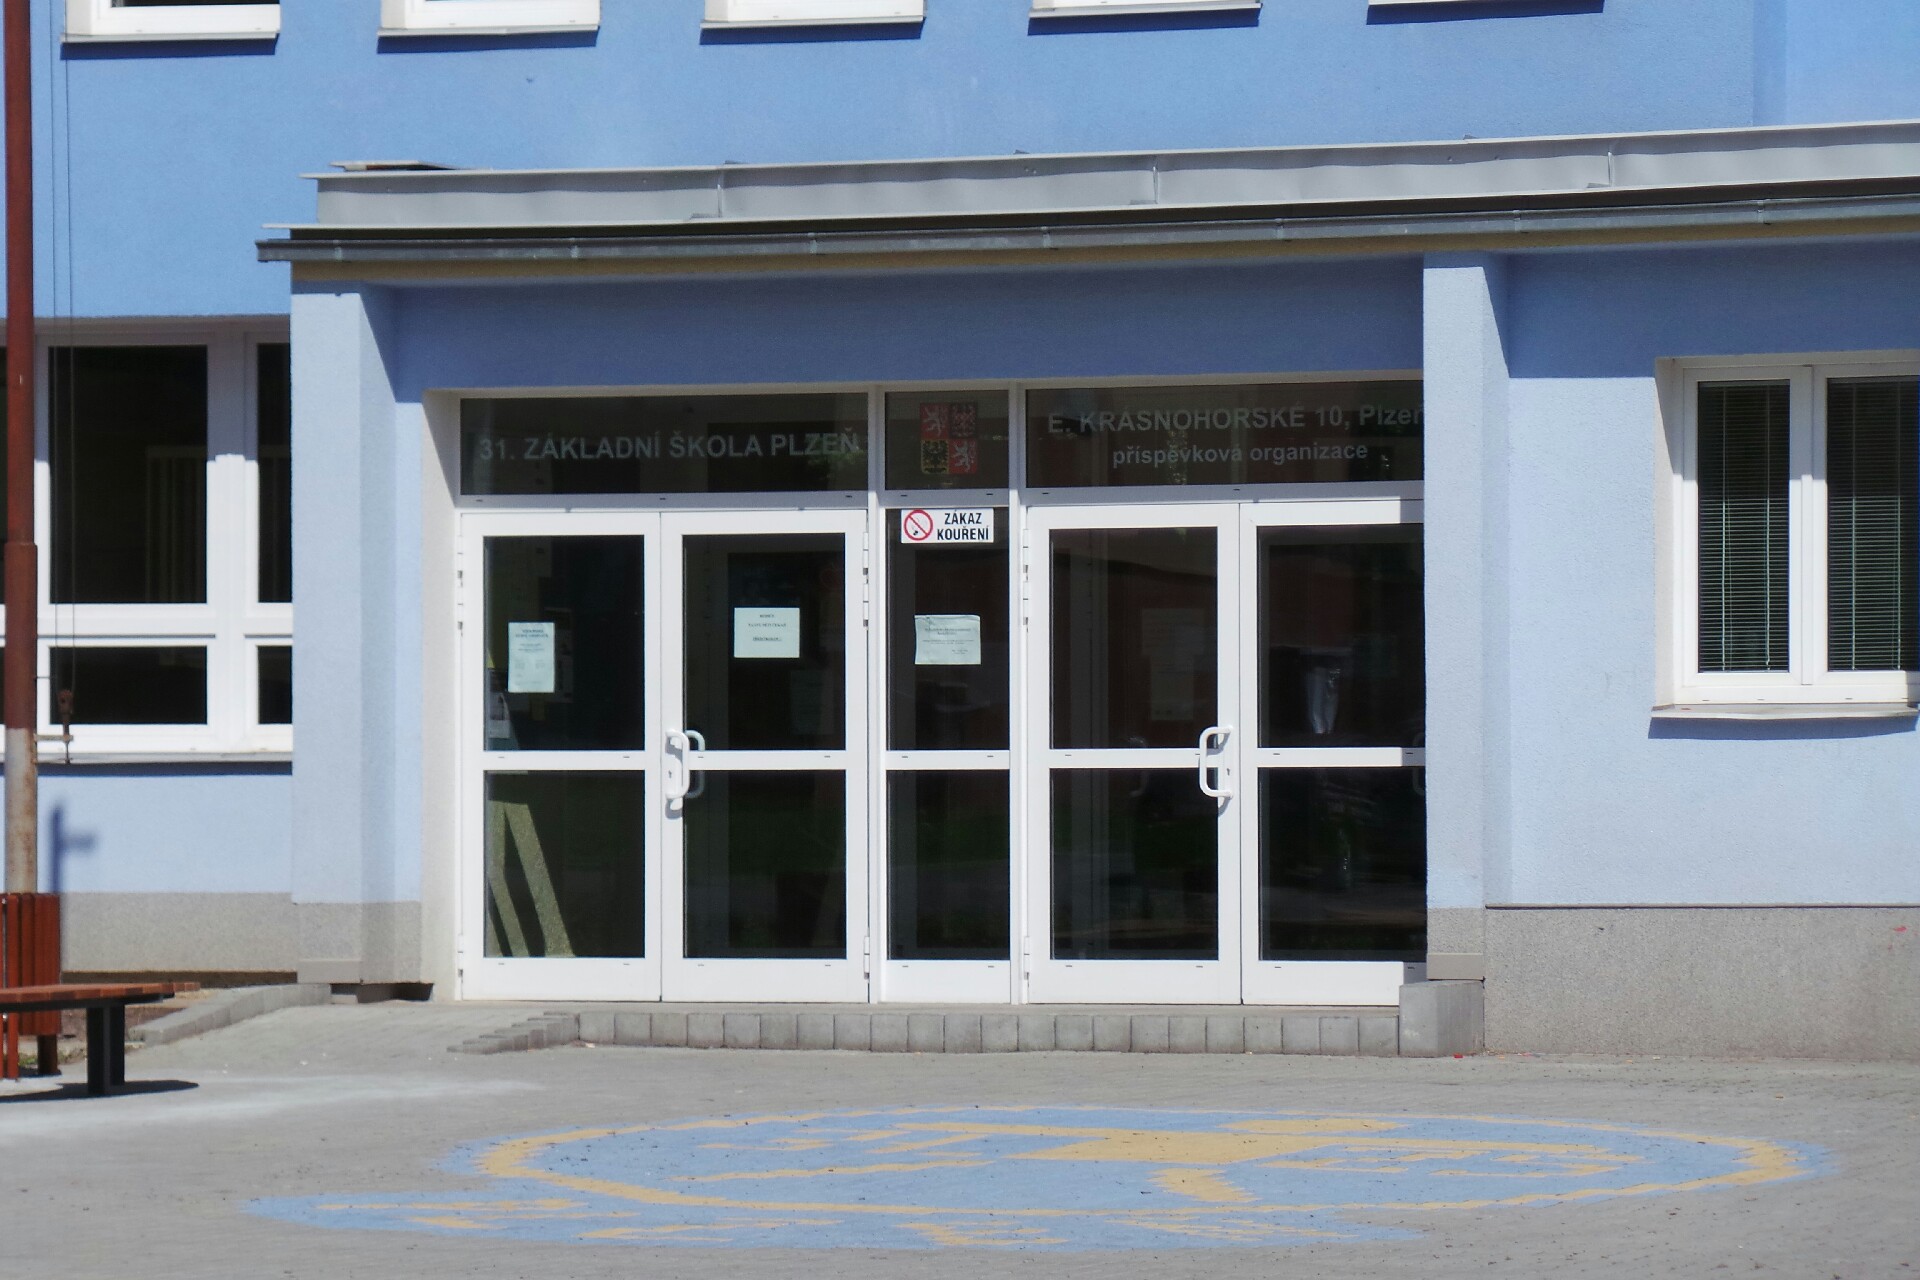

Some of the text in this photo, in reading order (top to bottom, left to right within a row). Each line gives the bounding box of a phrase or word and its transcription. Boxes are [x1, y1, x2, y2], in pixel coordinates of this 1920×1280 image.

[1048, 412, 1071, 434] E.
[1079, 401, 1305, 432] KRÁSNOHORSKÉ
[1314, 407, 1350, 430] 10,
[479, 427, 859, 461] 31. ZÁKLADNÍ ŠKOLA PLZEŇ
[1112, 442, 1368, 469] příspěvková organizace
[937, 510, 989, 541] ZÁKAZ KOUŘENÍ
